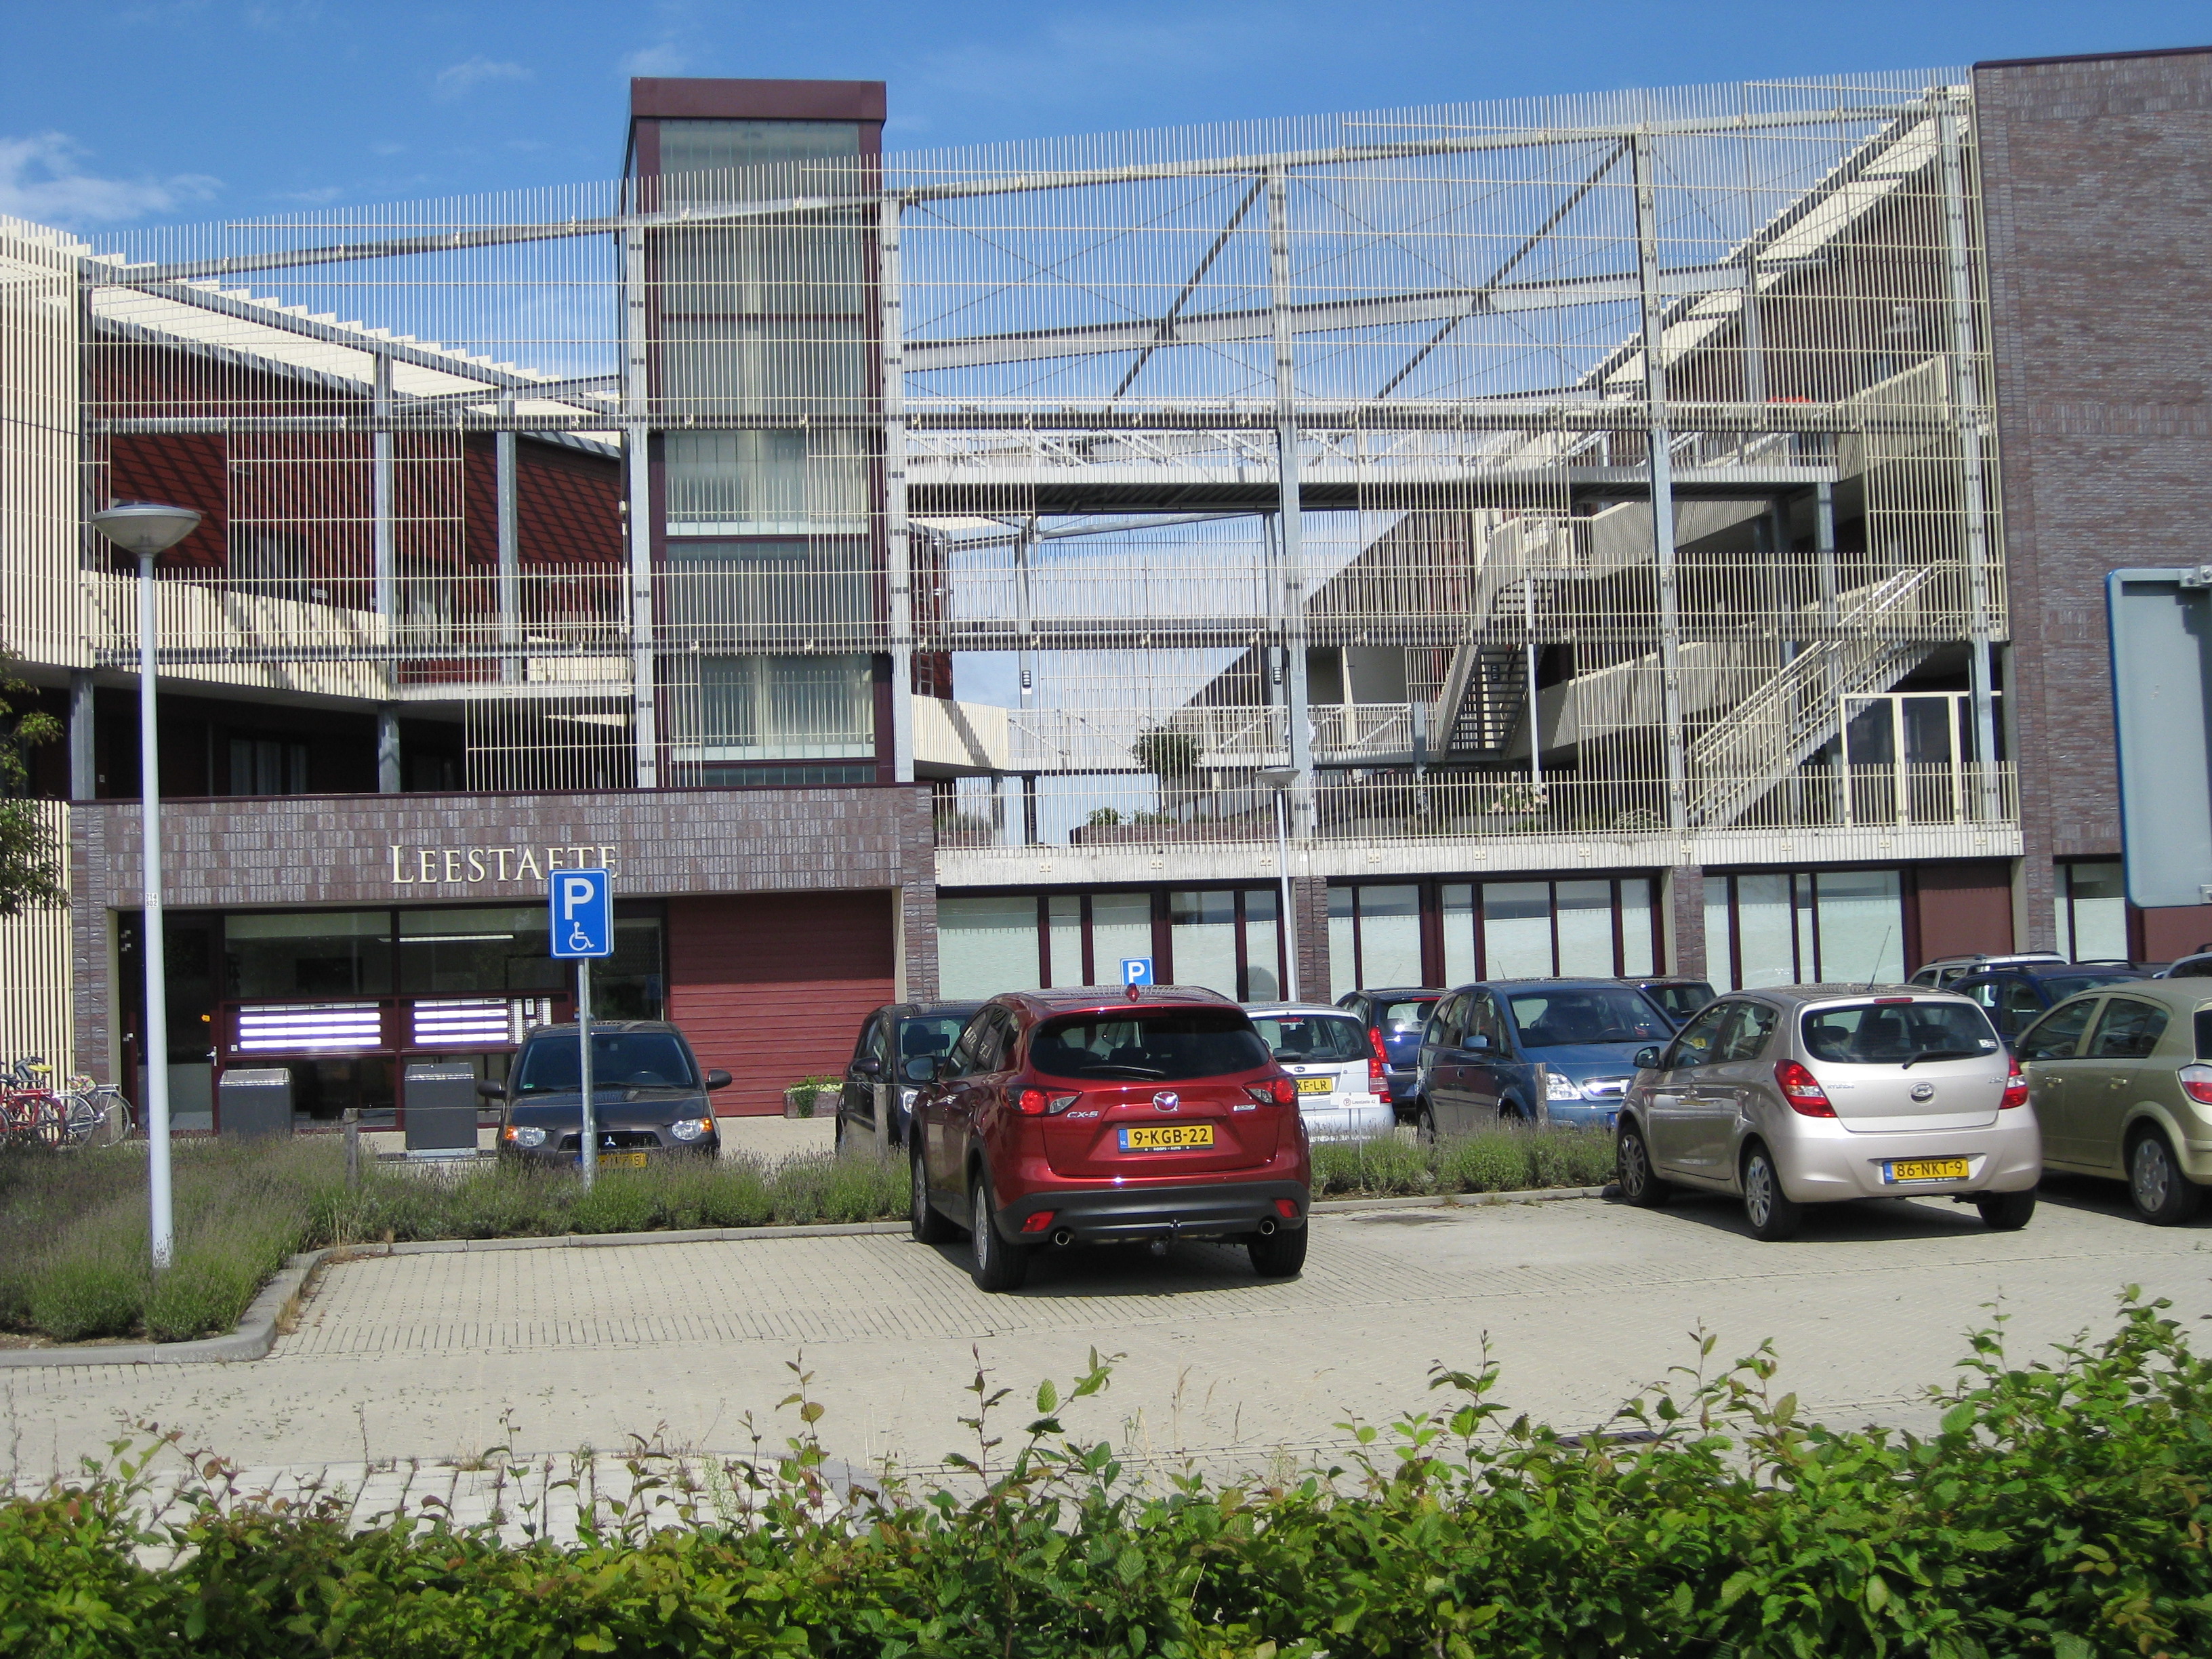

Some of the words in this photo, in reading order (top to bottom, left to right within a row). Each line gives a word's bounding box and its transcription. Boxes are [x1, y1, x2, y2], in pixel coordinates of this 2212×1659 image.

[564, 878, 594, 920] P
[1128, 962, 1145, 983] P
[1296, 1080, 1328, 1091] XF-LR
[1133, 1128, 1209, 1145] 9-KGB-22
[1896, 1161, 1963, 1177] 86-NKT-9
